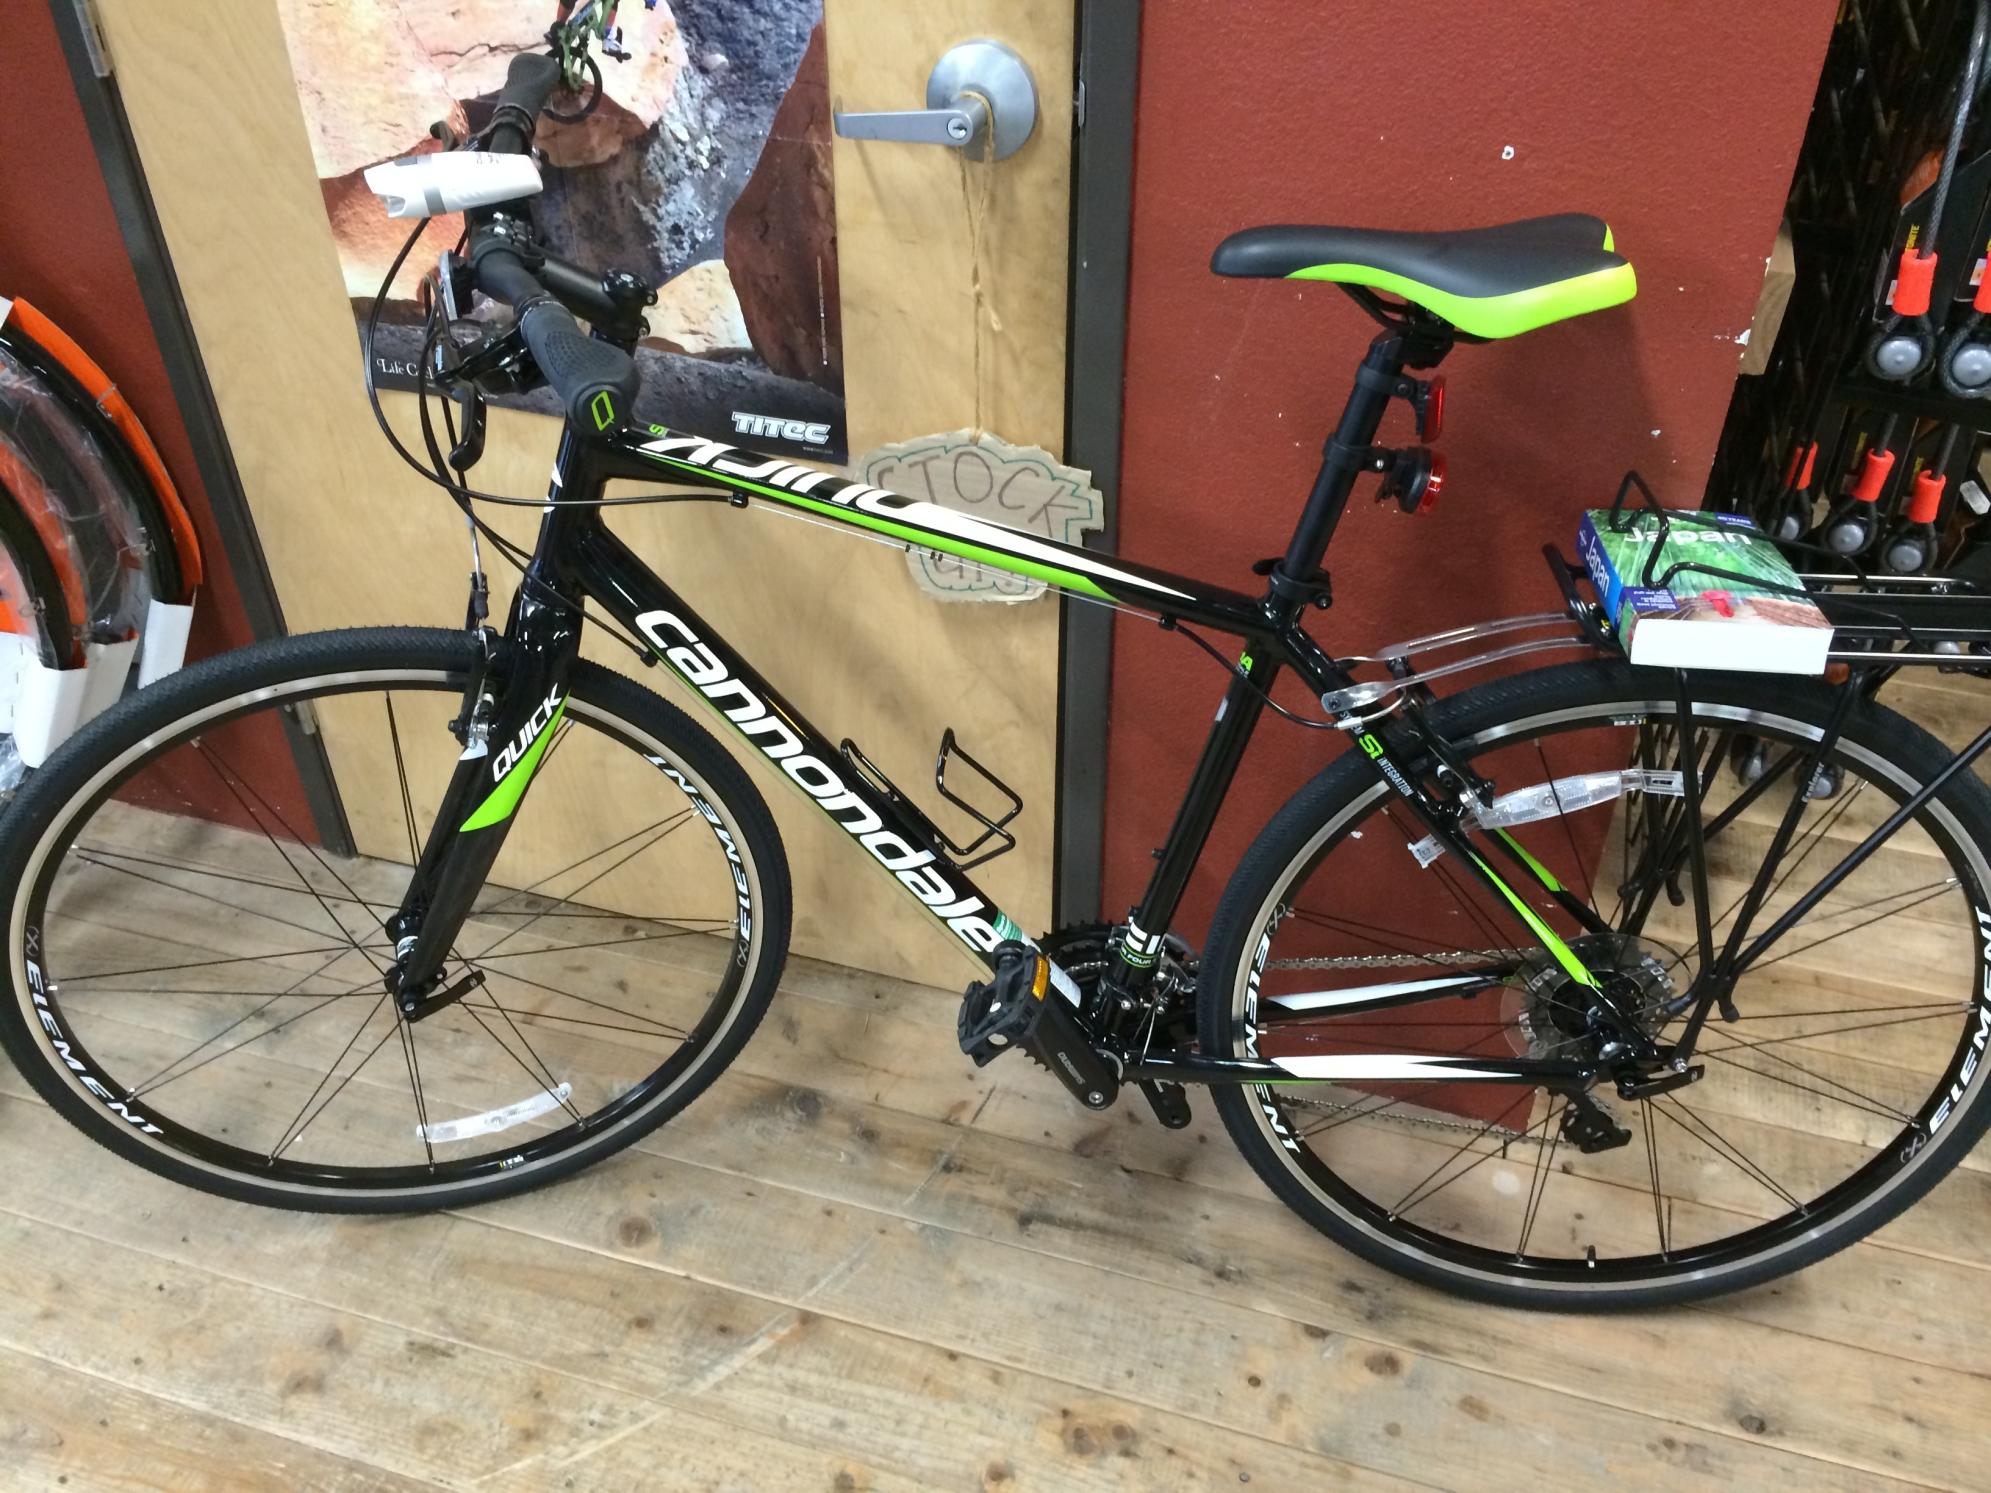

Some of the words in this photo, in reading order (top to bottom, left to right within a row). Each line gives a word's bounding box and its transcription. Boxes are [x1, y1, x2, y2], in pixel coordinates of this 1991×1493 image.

[1586, 535, 1611, 597] Japan
[1625, 527, 1753, 545] Japan
[492, 682, 562, 783] QUICK
